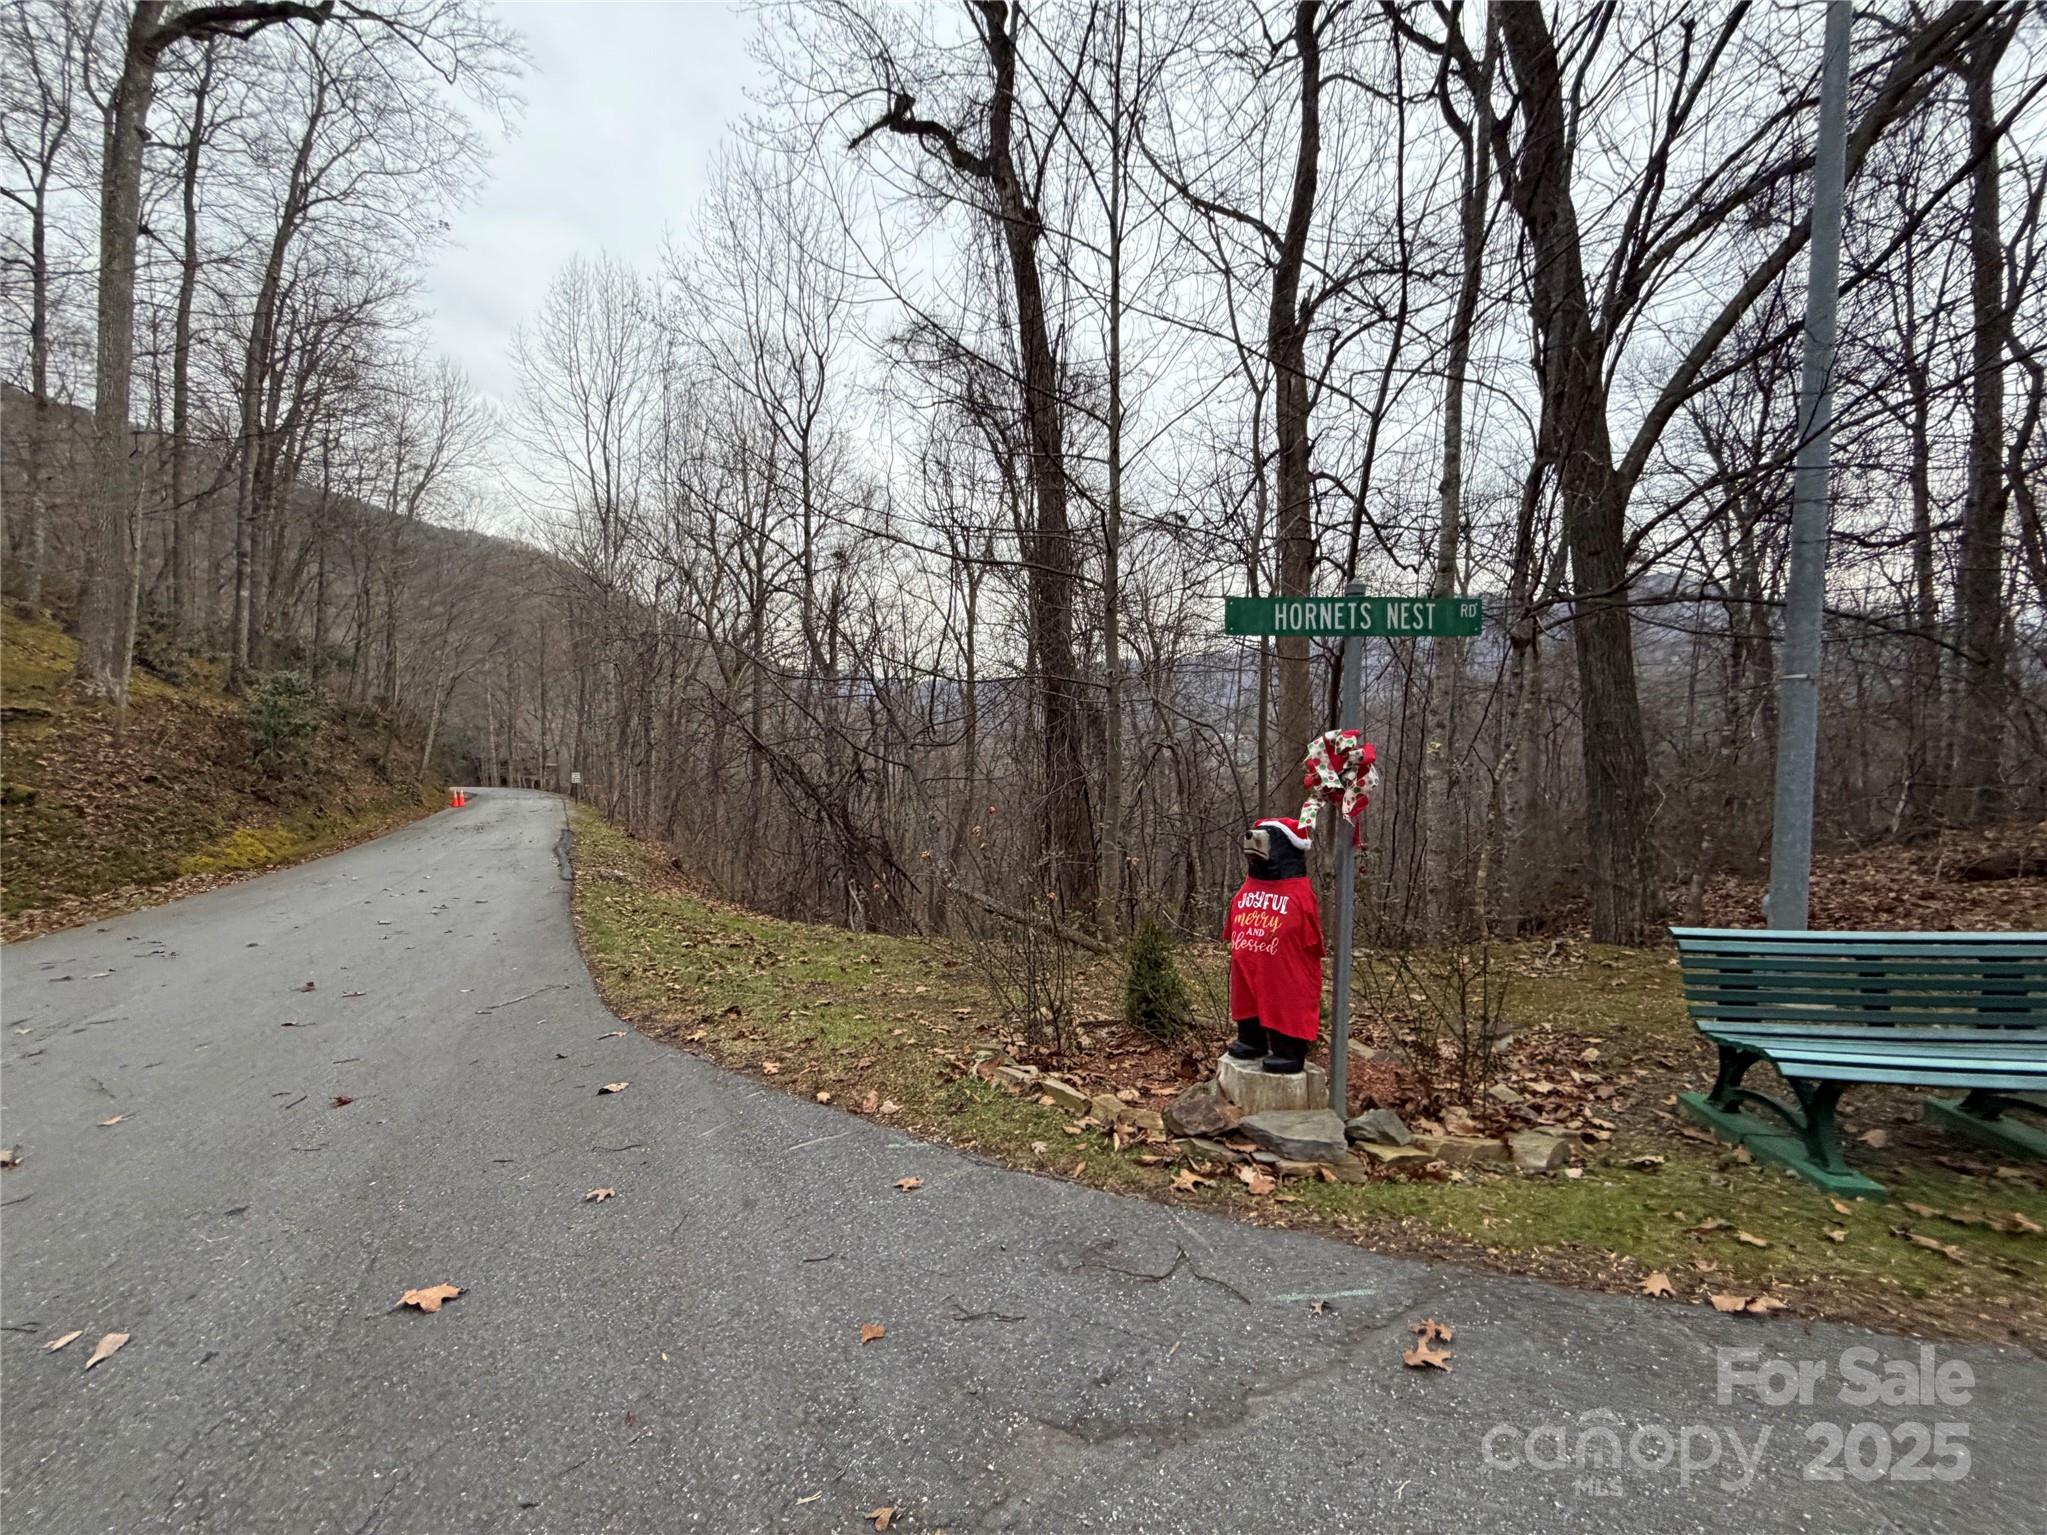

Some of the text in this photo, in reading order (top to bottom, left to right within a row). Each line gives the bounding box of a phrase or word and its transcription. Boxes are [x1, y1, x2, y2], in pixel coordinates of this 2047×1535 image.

[1274, 602, 1477, 630] HORNETS NEST RD
[1237, 890, 1289, 915] JOYFUL
[1234, 910, 1282, 933] merry
[1246, 927, 1265, 937] AND
